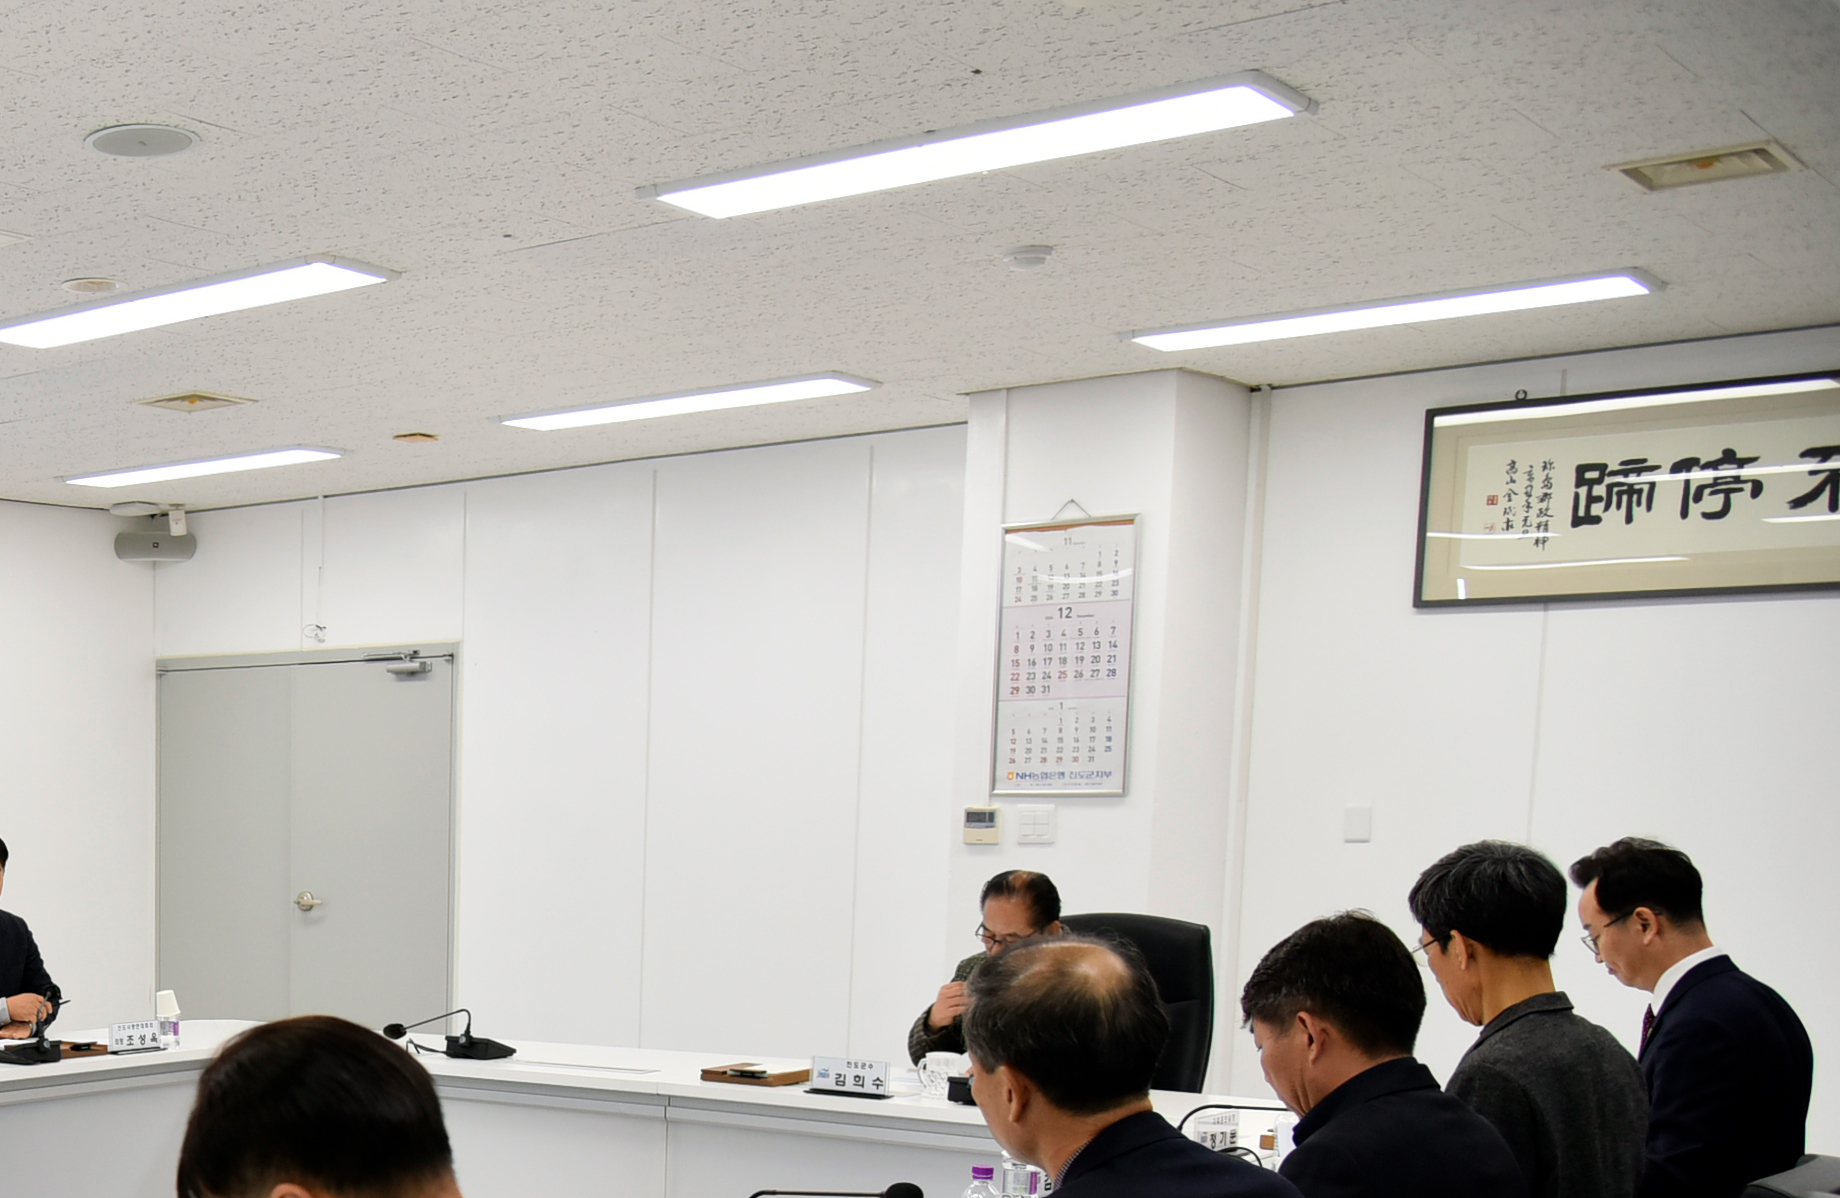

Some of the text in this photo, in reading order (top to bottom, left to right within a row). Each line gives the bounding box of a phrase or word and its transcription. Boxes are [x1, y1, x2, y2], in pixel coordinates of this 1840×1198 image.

[1064, 537, 1072, 545] 11
[1058, 607, 1072, 619] 12
[1016, 631, 1020, 640] 1
[1030, 631, 1035, 639] 2
[1046, 630, 1051, 638] 3
[1078, 628, 1083, 636] 5
[1094, 627, 1099, 635] 6
[1110, 626, 1116, 634] 7
[1014, 640, 1118, 653] 8 9 10 11 12 13 14
[1011, 654, 1116, 667] 15 16 17 18 19 20 21
[1010, 668, 1116, 681] 22 23 24 25 26 27 28
[1010, 685, 1050, 695] 29 30 31
[1016, 772, 1065, 780] NH농협은행
[834, 1072, 885, 1091] 김희수
